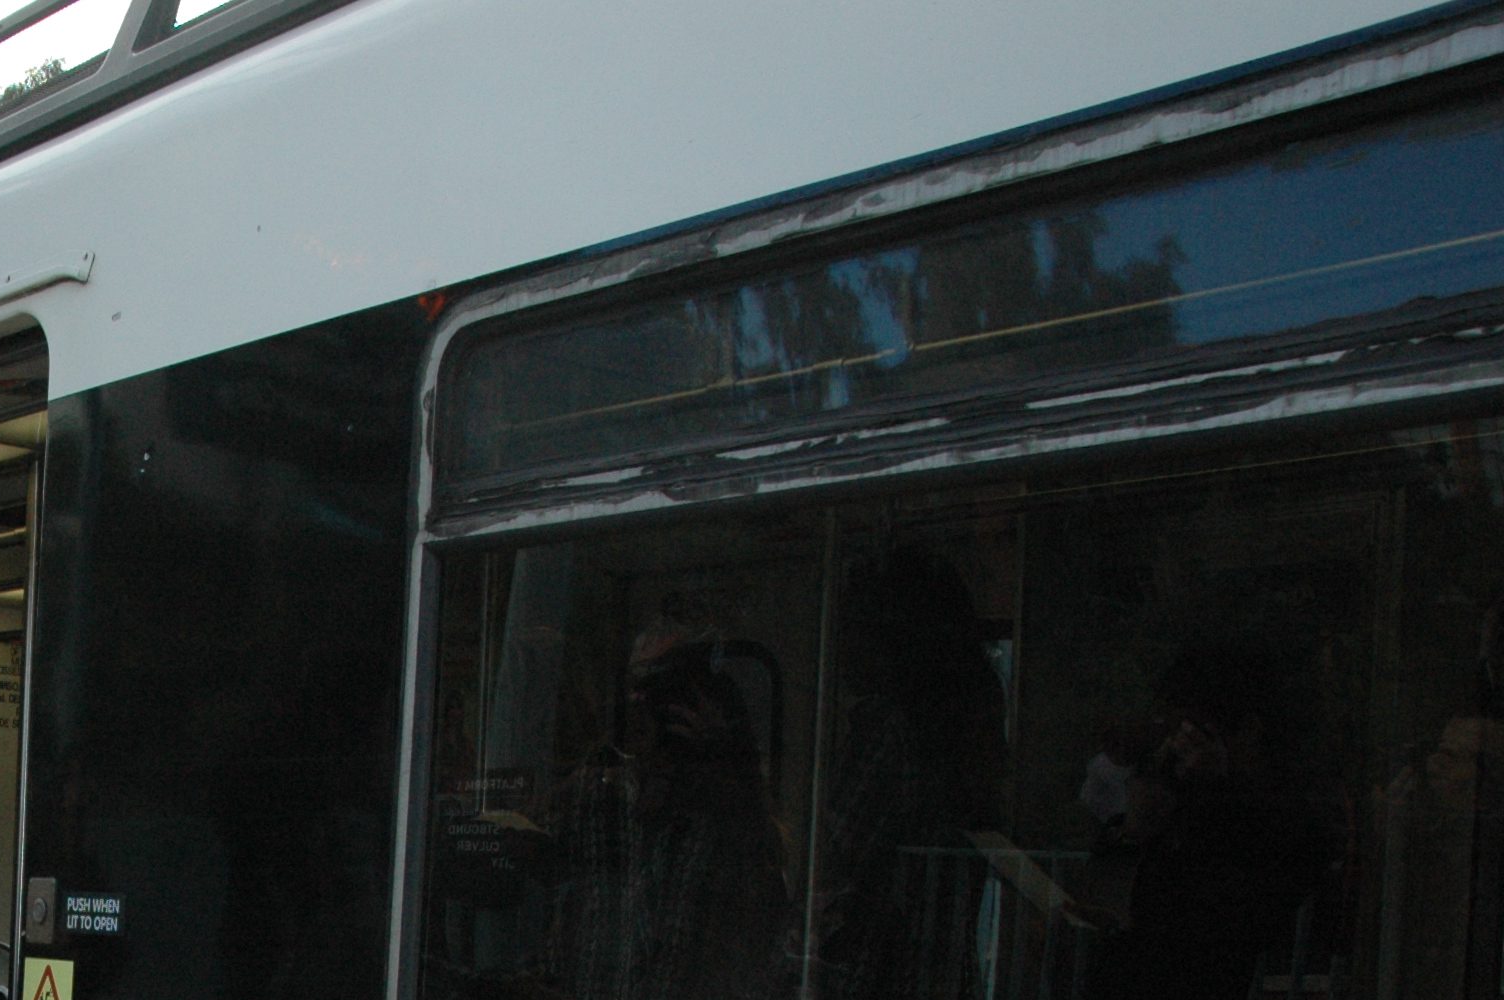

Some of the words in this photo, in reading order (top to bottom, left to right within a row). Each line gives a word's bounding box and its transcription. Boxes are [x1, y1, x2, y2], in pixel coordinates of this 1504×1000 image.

[67, 896, 91, 912] PUSH
[92, 898, 120, 914] WHEN
[67, 914, 78, 929] LIT
[79, 914, 92, 930] TO
[93, 915, 118, 932] OPEN
